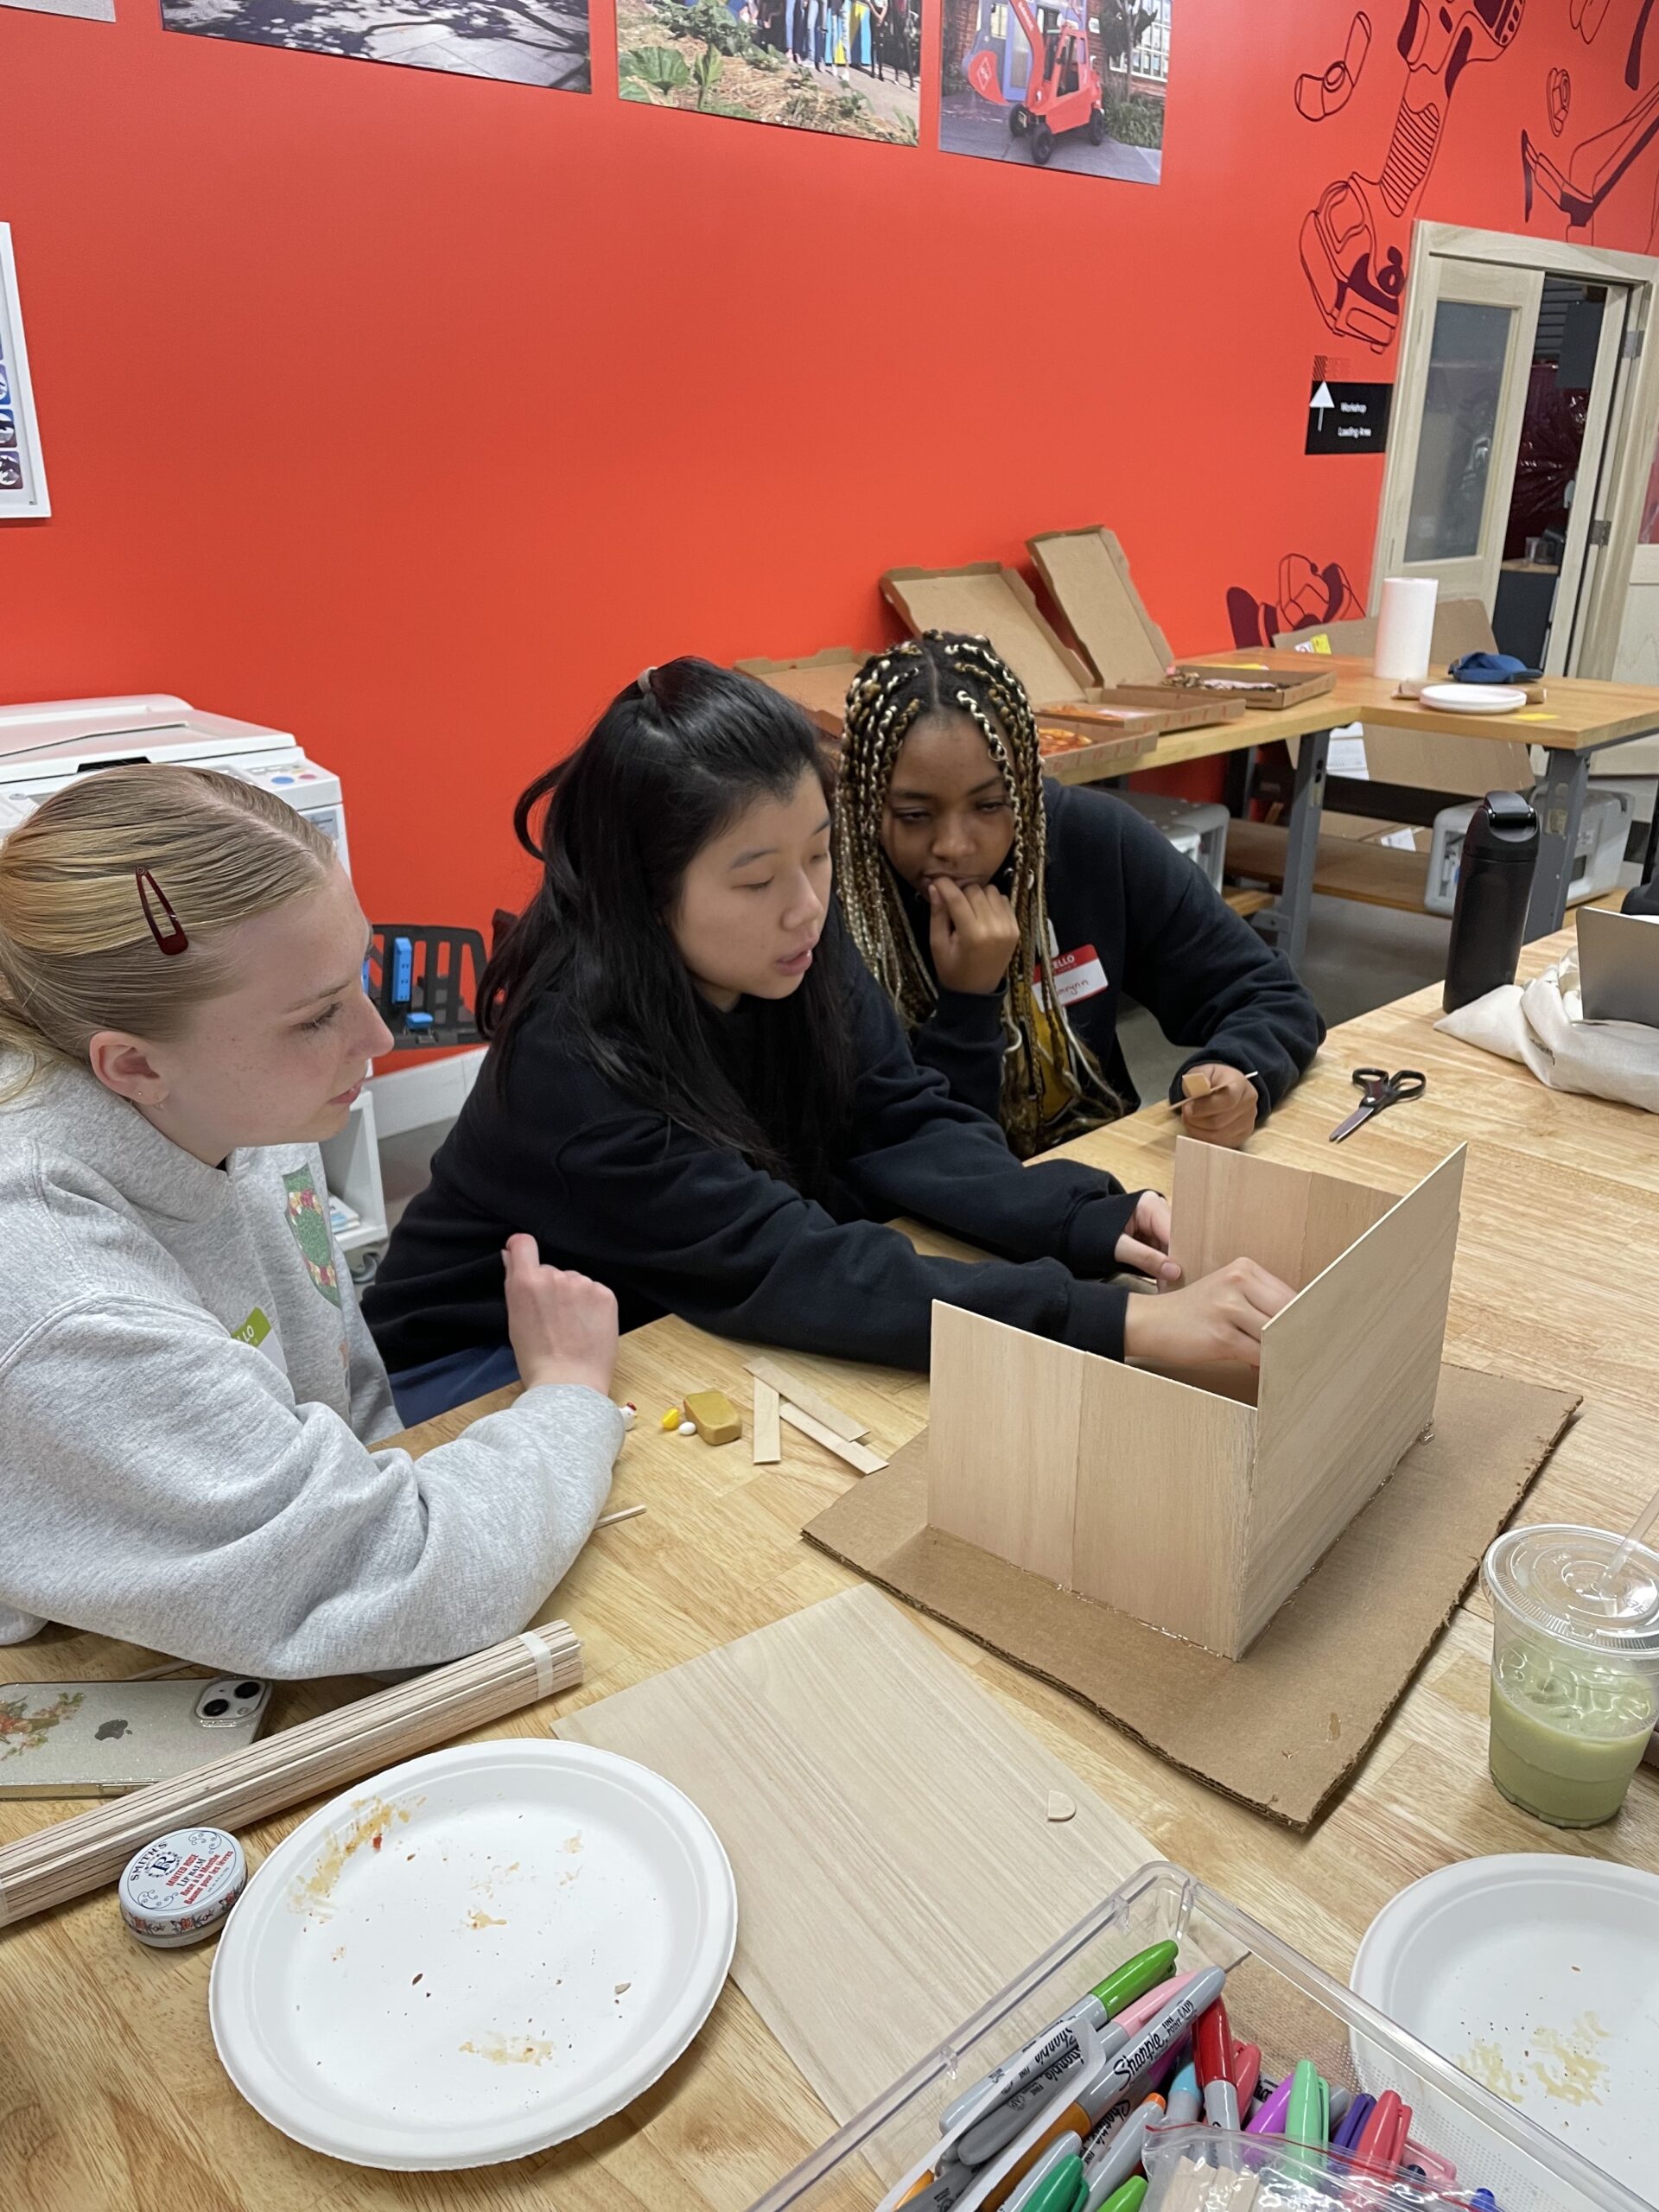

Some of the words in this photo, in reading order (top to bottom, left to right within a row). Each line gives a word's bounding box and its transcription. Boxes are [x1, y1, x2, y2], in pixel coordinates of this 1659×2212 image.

[1052, 955, 1075, 969] ELLO
[130, 1841, 168, 1881] SMITH'S
[166, 1866, 188, 1887] MINTED
[183, 1853, 199, 1866] ROSE
[176, 1876, 190, 1886] LIP
[188, 1858, 207, 1876] BALM
[1113, 2032, 1165, 2091] Sharpie
